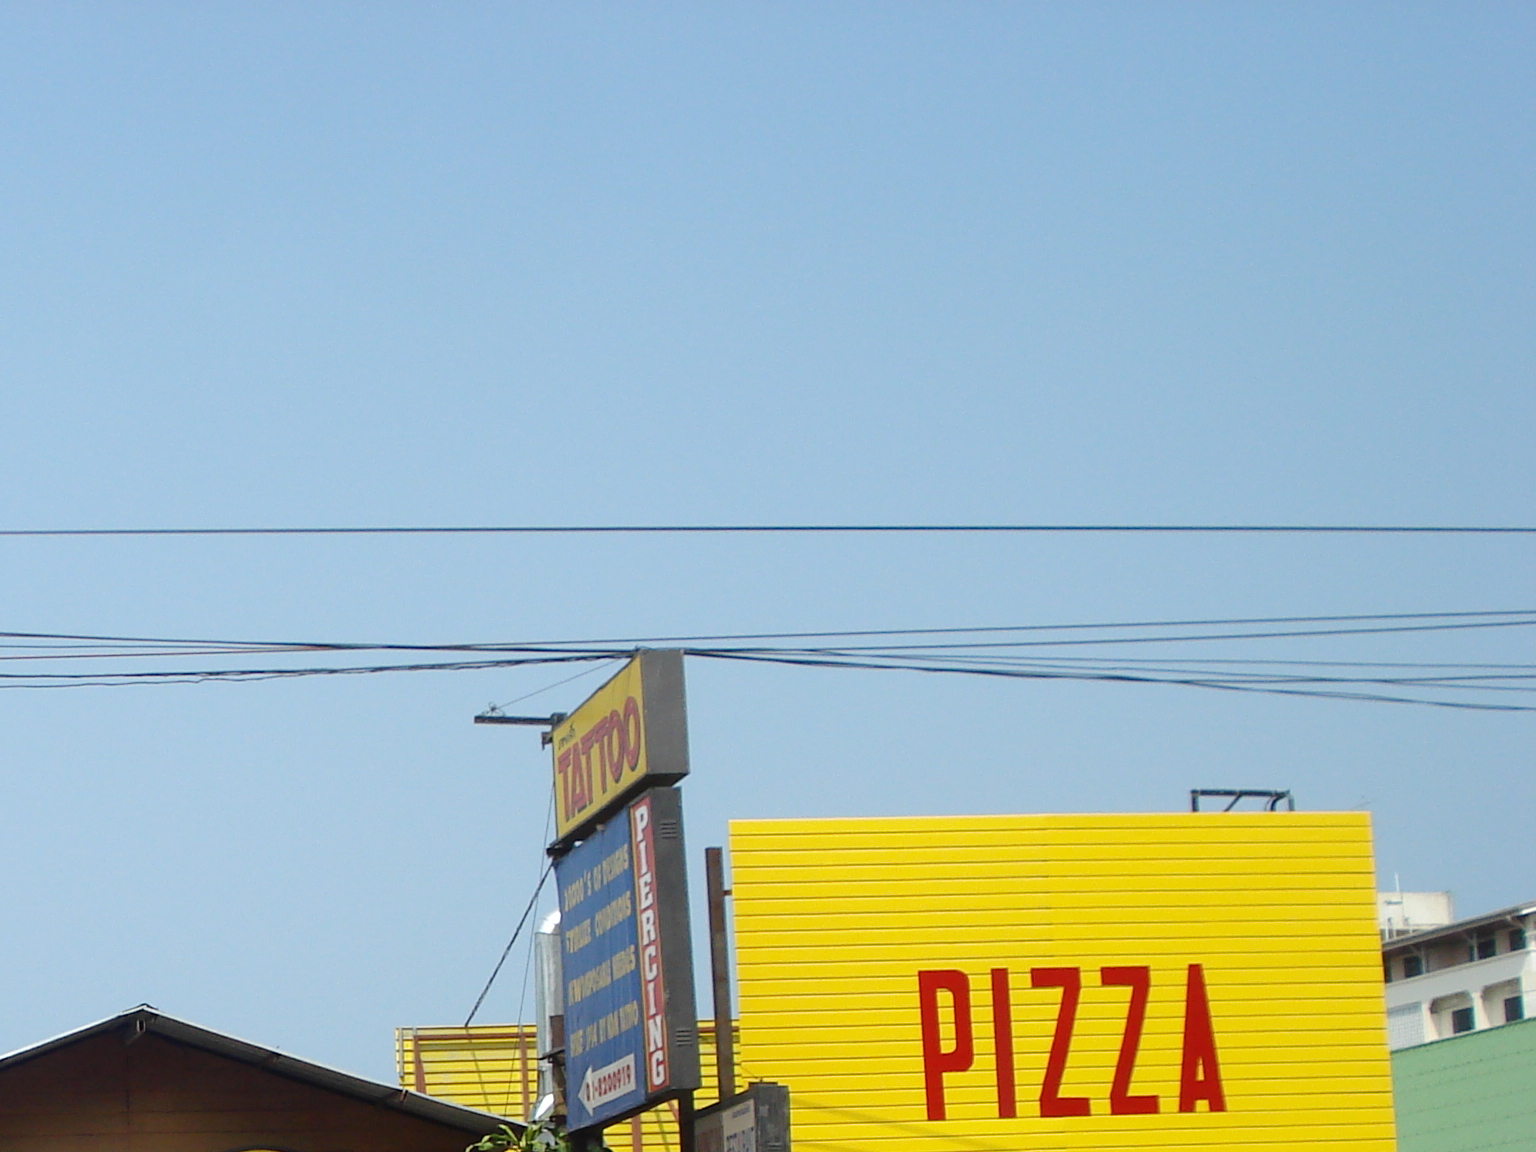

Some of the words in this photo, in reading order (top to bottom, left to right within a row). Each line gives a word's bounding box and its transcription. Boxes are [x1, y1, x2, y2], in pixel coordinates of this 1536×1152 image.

[557, 696, 641, 822] TATTOO
[634, 804, 666, 1086] PIERCING
[918, 963, 1227, 1121] PIZZA
